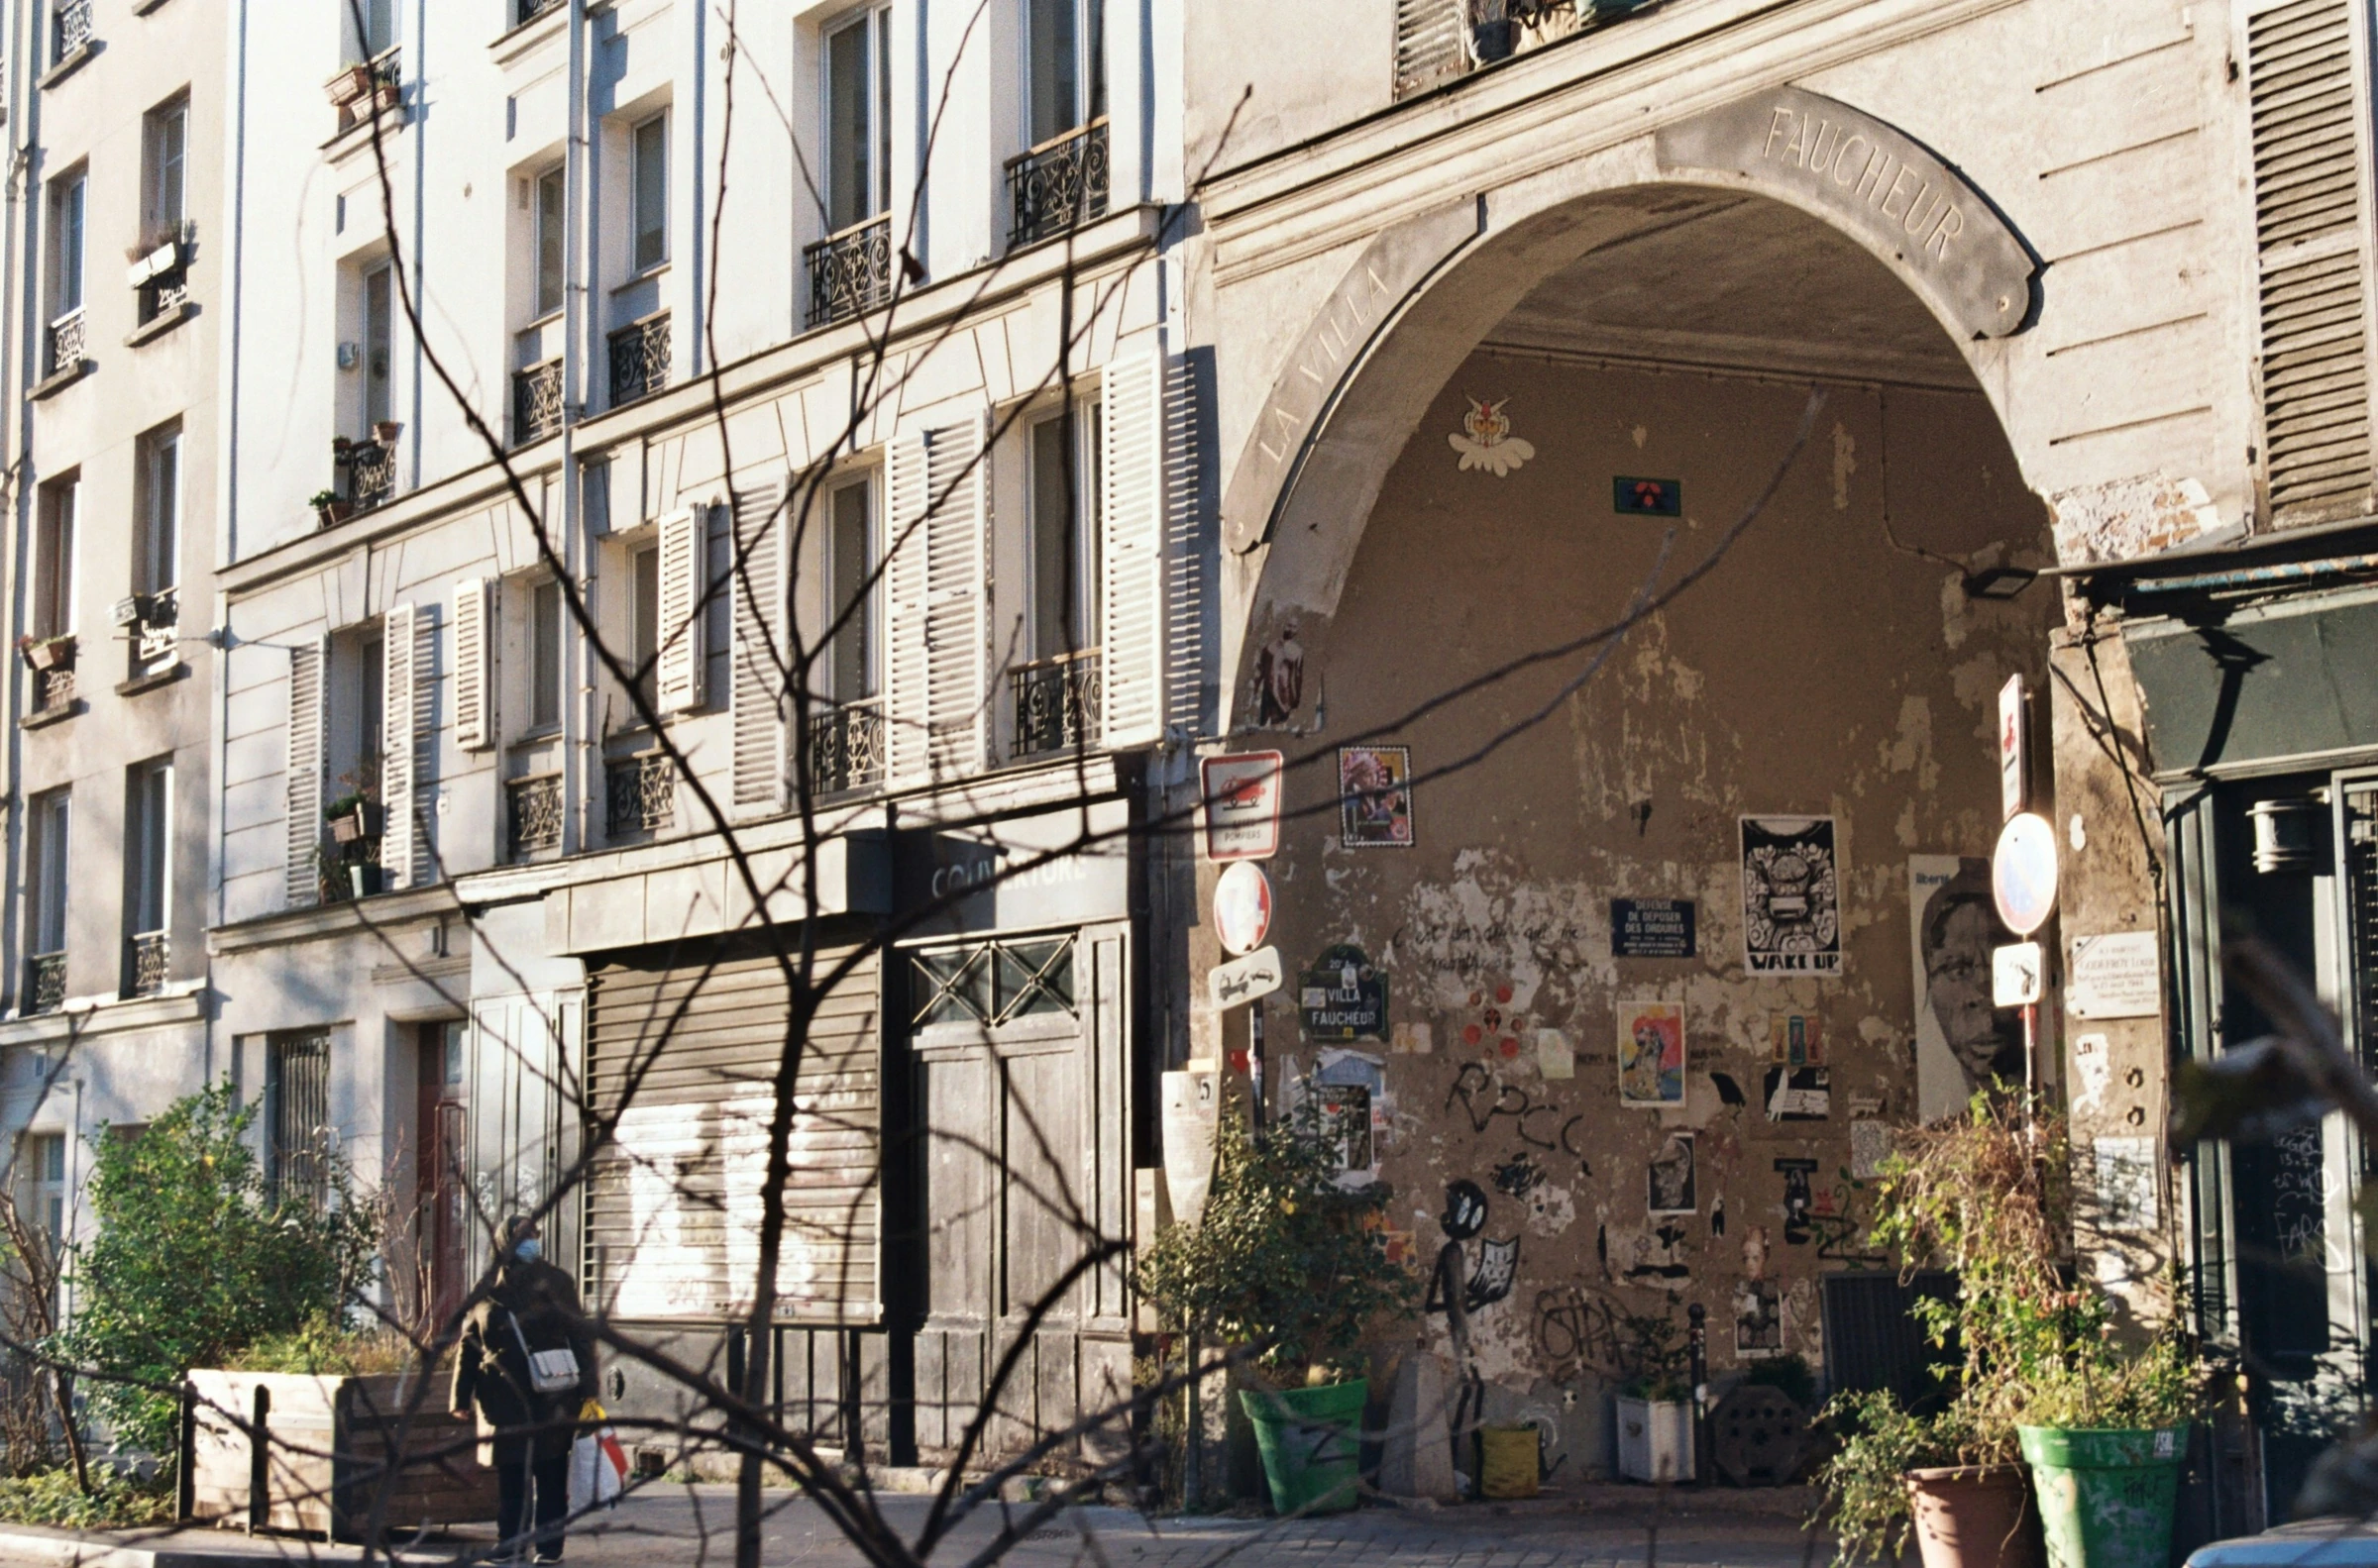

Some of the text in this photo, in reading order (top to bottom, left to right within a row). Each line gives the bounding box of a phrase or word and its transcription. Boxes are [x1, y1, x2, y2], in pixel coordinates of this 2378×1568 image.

[1764, 106, 1964, 263] FAUCHEUR
[1259, 265, 1389, 464] LA VILLA
[1224, 830, 1261, 842] POMPIERS
[1628, 911, 1639, 921] DE
[1625, 923, 1684, 934] DES ORDURES
[1749, 954, 1839, 970] WAKE UP
[1327, 989, 1361, 1002] VILLA
